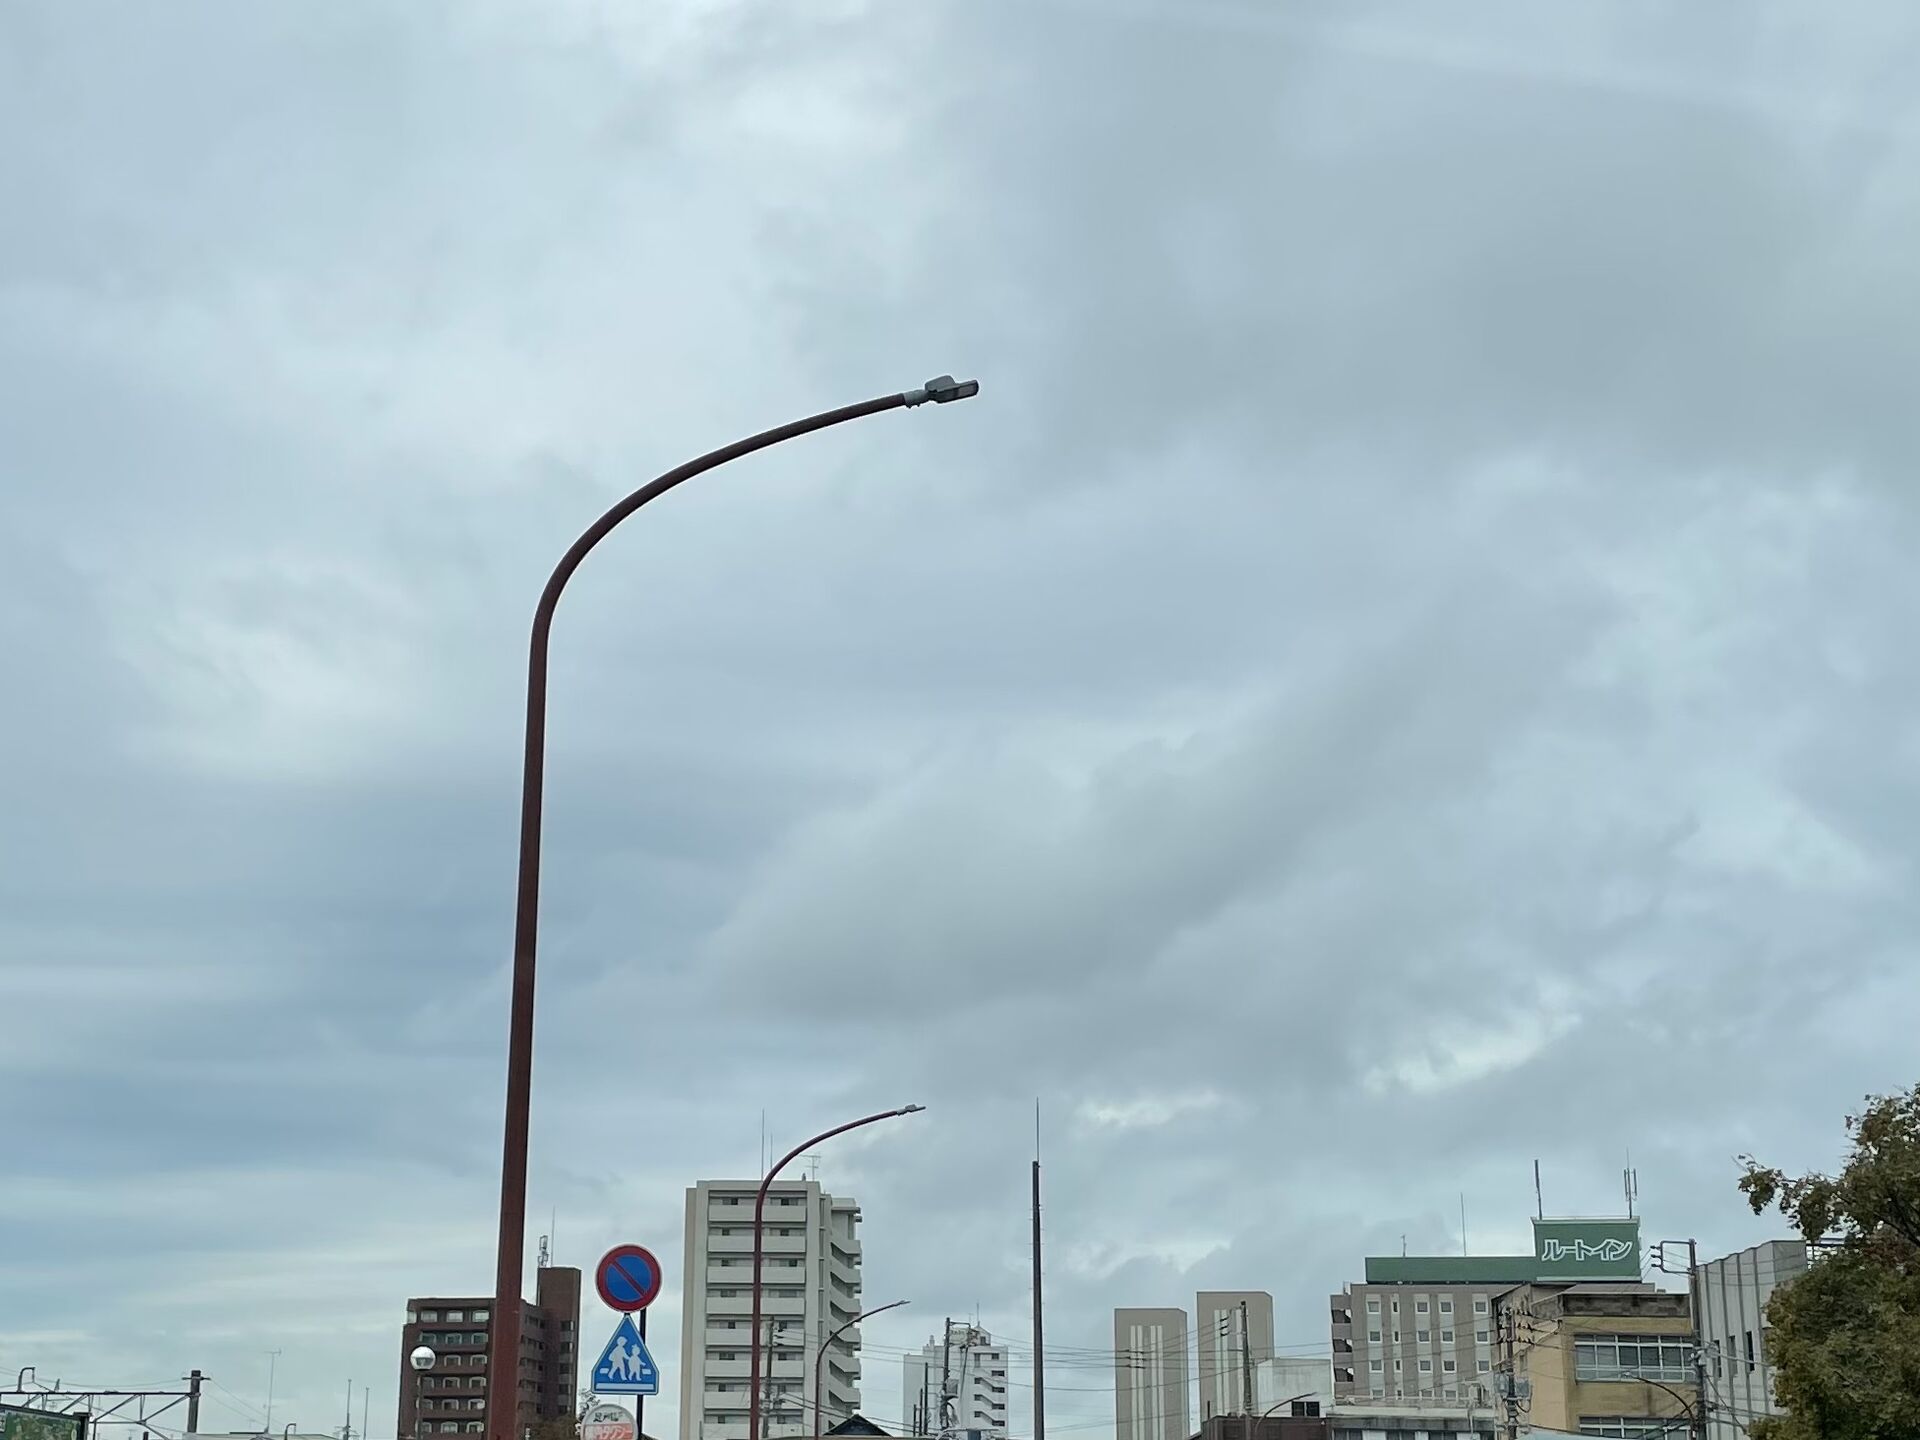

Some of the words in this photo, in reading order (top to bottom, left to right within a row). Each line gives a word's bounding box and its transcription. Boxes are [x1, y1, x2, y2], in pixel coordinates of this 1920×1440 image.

[1541, 1238, 1633, 1261] ルートイン
